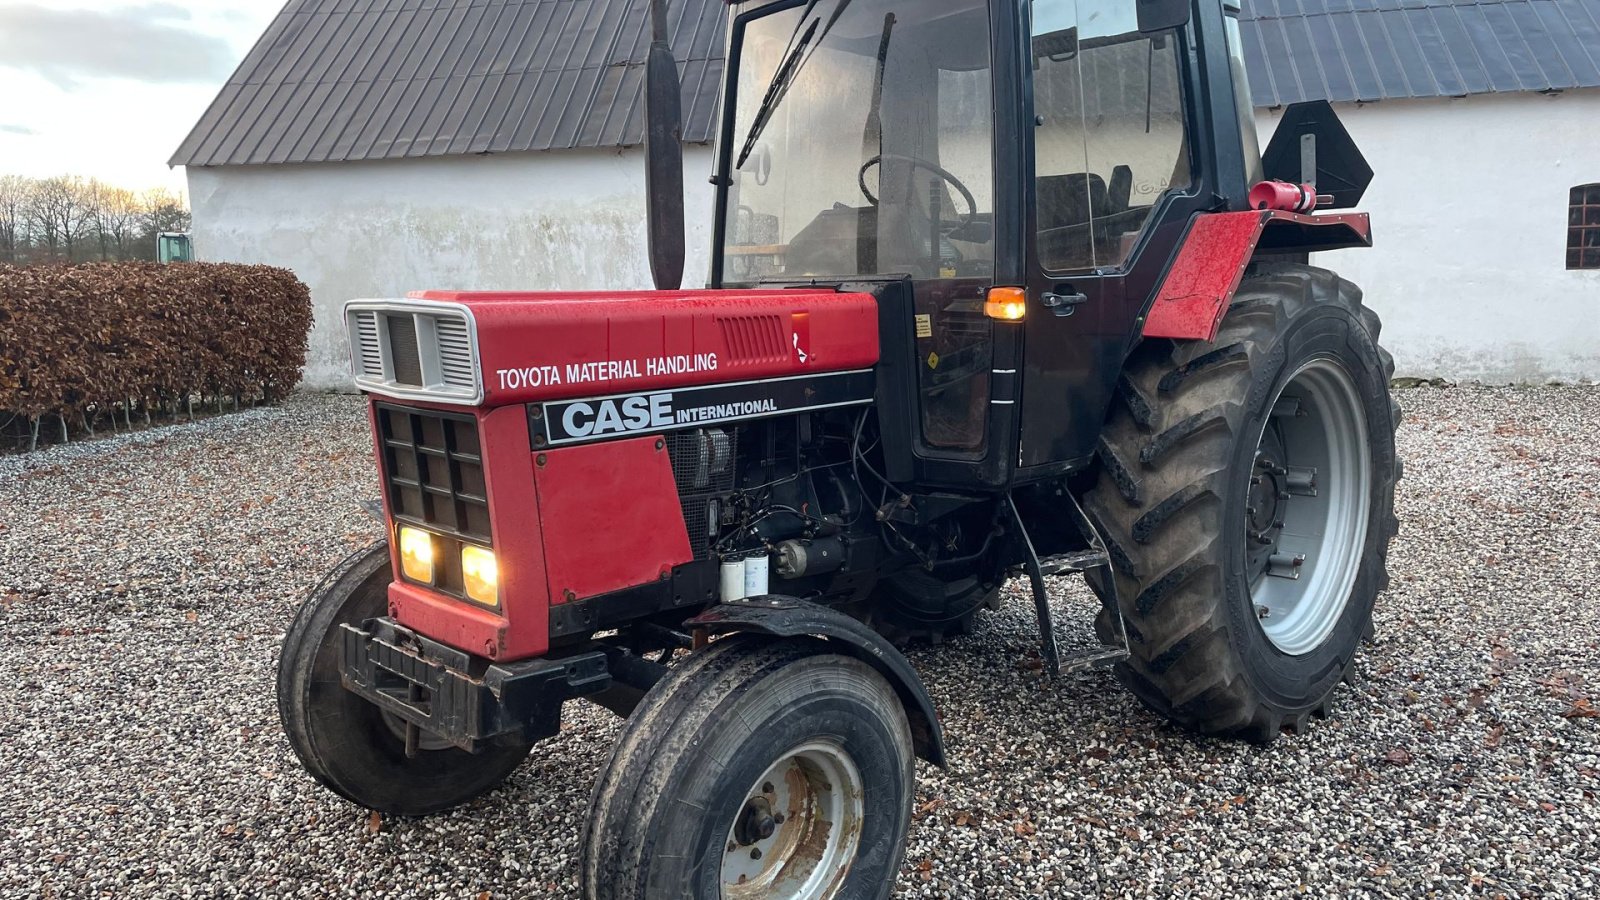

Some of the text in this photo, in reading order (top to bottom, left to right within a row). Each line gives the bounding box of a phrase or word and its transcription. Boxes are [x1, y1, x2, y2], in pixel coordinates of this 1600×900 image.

[497, 352, 718, 390] TOYOTA MATERIAL HANDLING
[562, 393, 777, 437] CASE INTERNATIONAL
